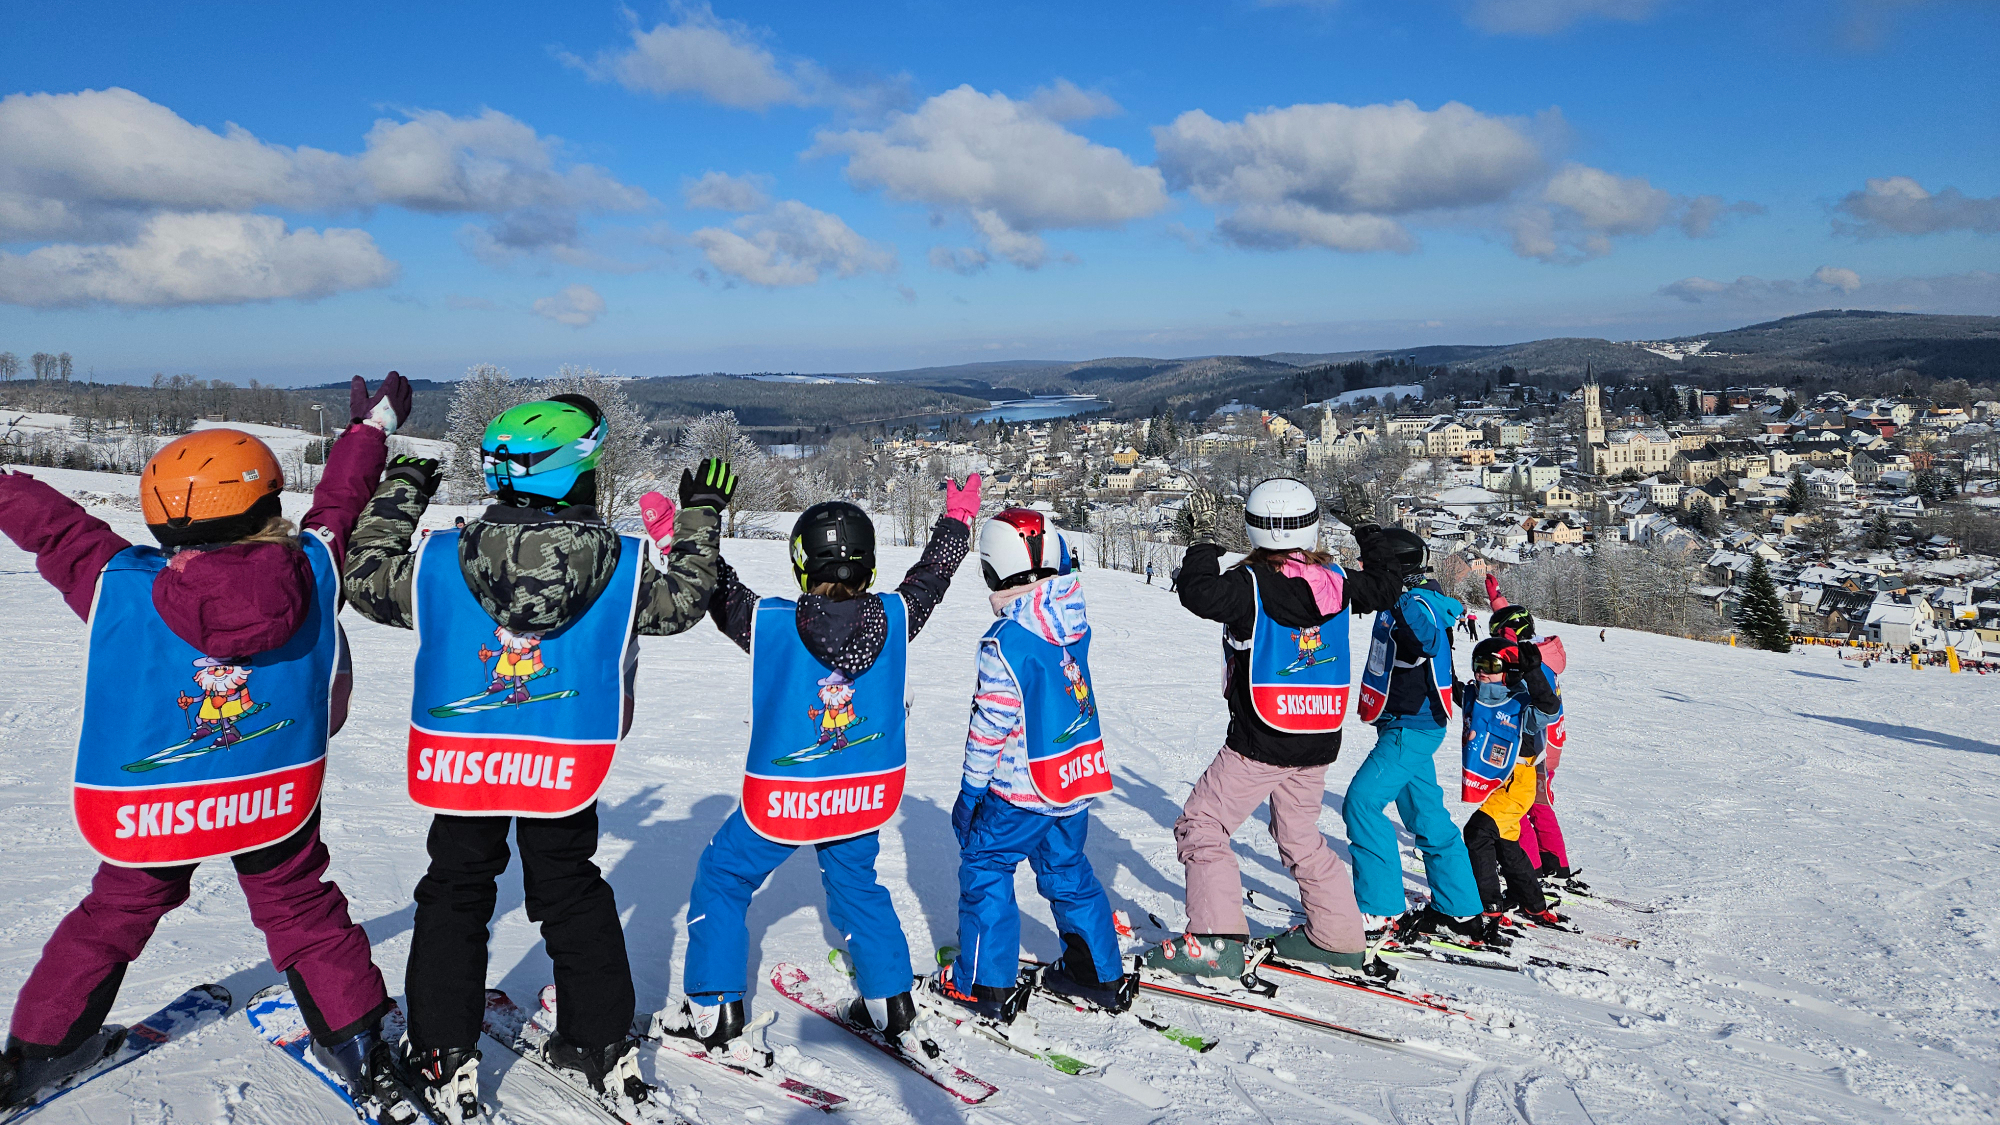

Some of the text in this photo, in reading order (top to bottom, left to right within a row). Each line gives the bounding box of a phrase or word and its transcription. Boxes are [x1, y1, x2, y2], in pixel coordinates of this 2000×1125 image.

[1276, 694, 1342, 715] SKISCHULE
[1495, 710, 1512, 724] SKI
[416, 748, 576, 790] SKISCHULE
[115, 783, 294, 839] SKISCHULE
[767, 783, 886, 820] SKISCHULE
